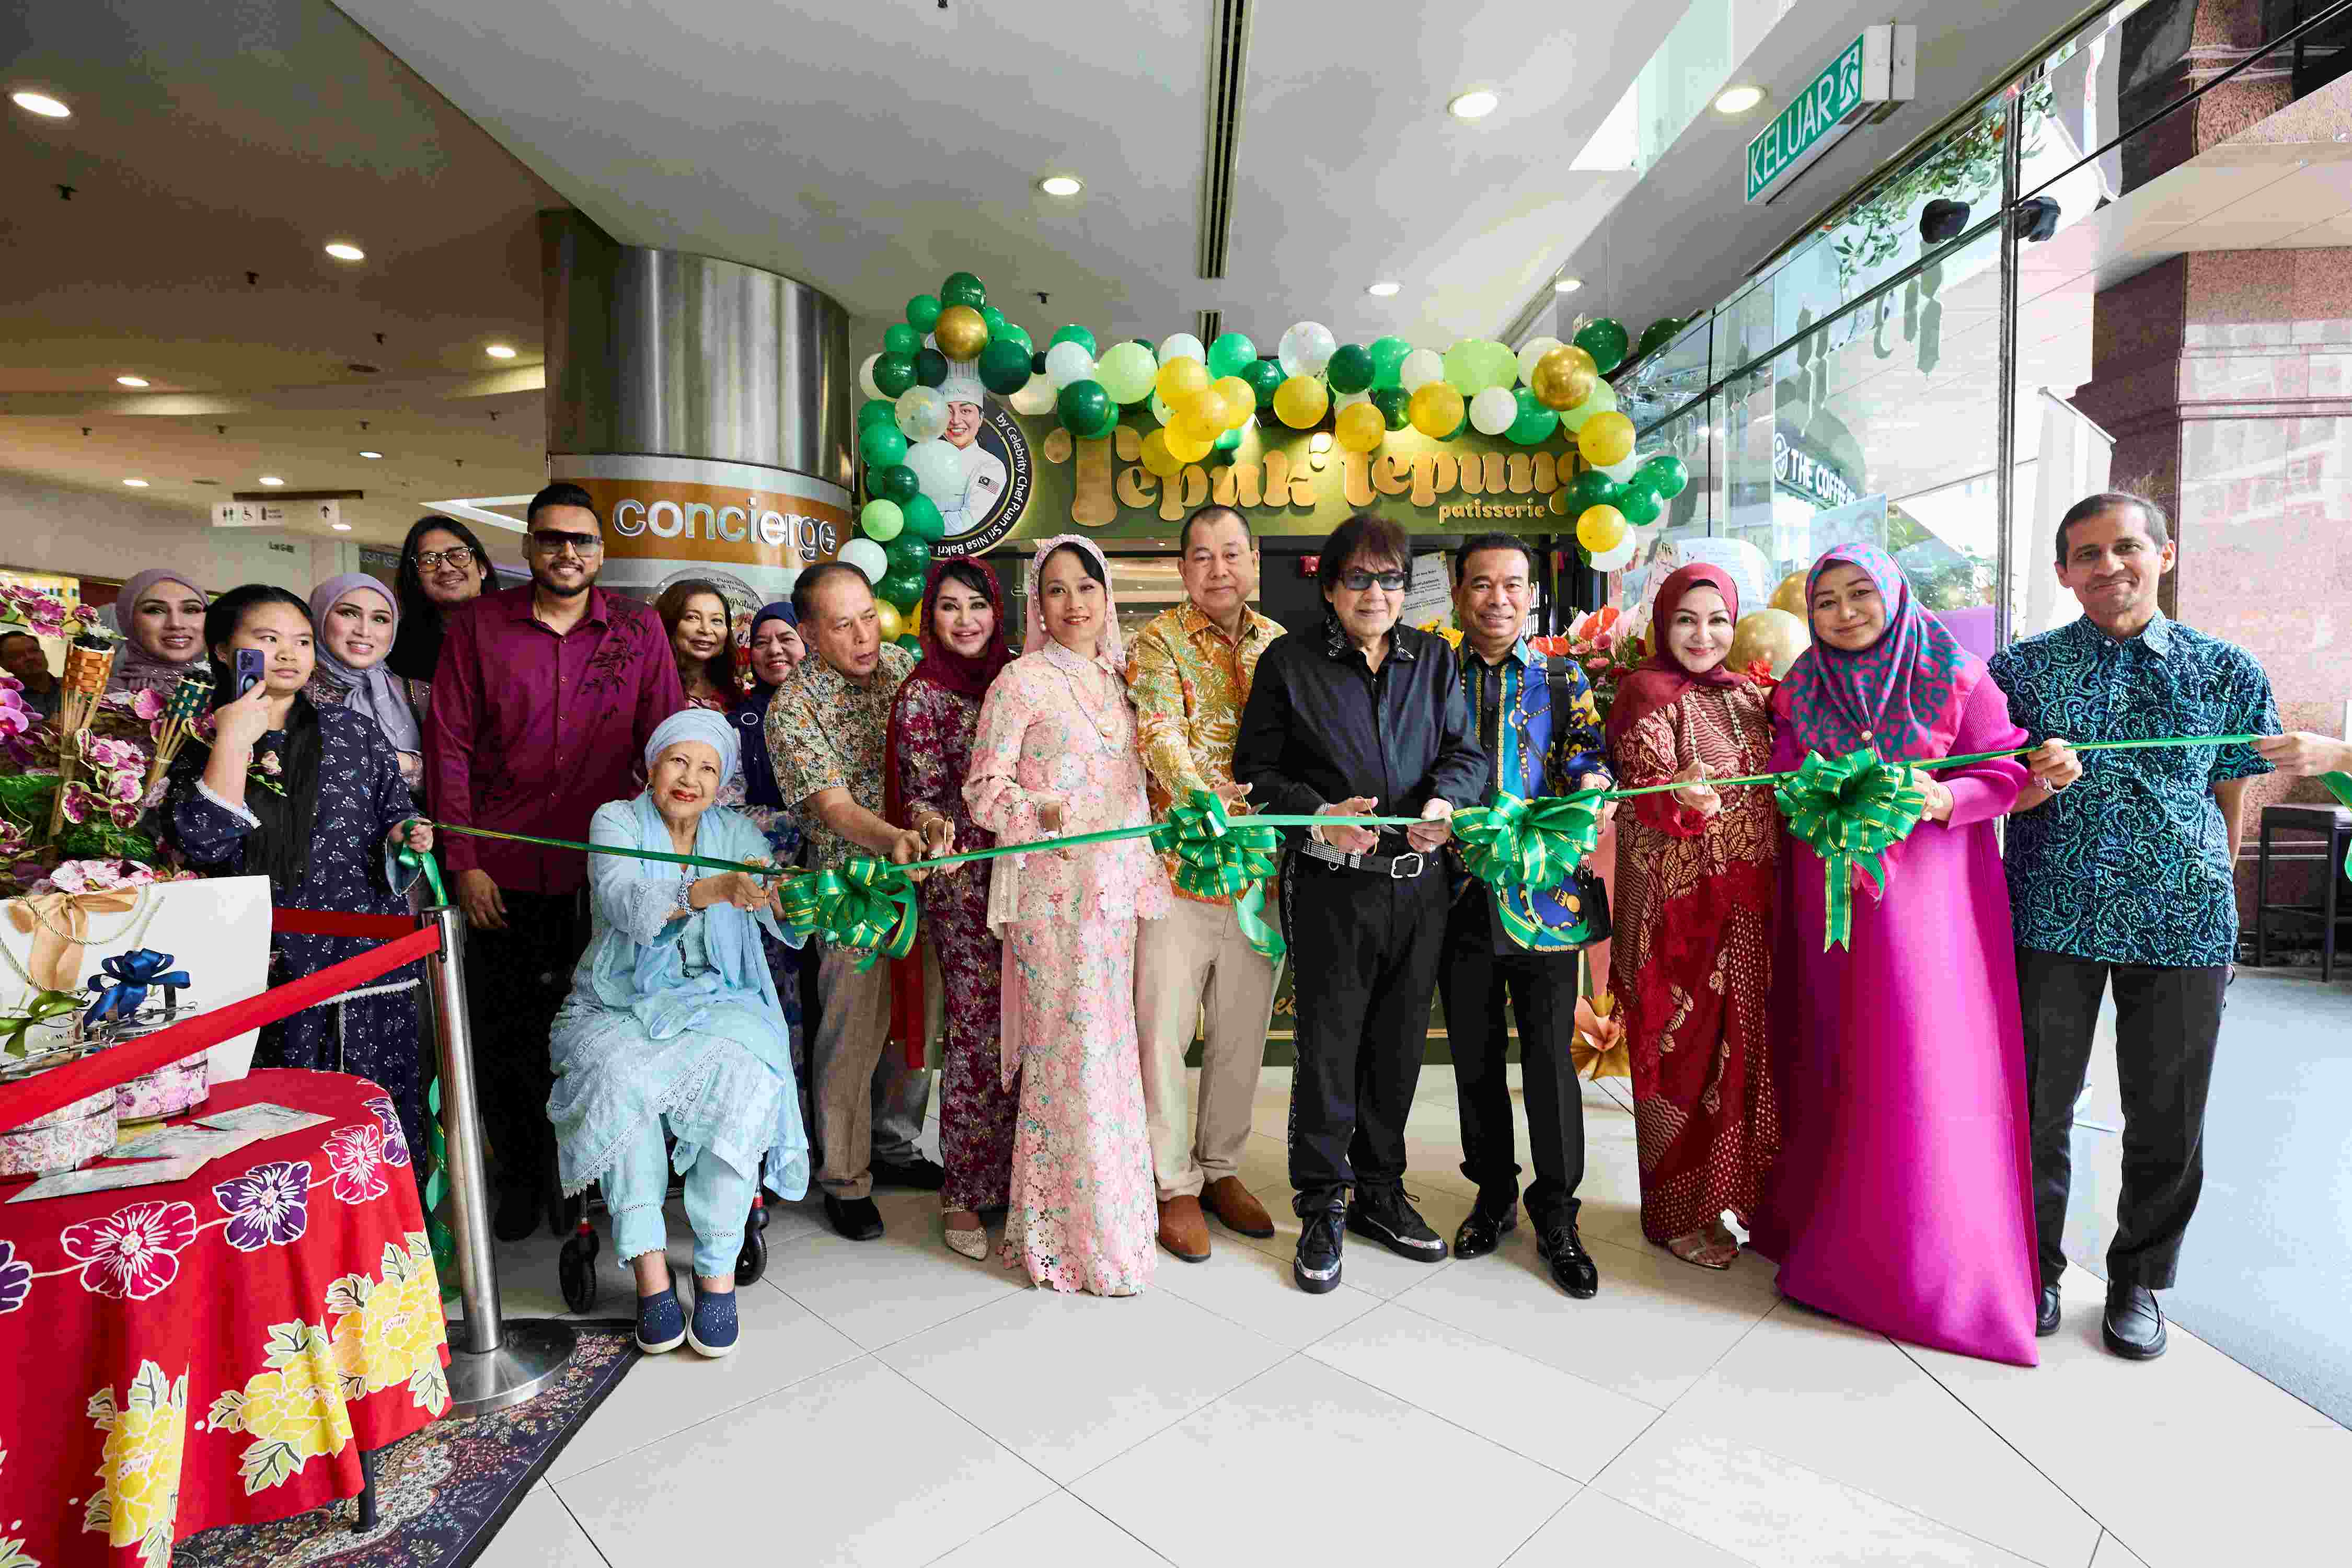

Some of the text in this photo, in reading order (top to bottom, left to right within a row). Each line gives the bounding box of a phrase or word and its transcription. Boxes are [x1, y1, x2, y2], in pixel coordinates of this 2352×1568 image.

[1751, 74, 1834, 192] KELUAR
[937, 412, 1028, 557] by Celebrity Chef Puan Sri Nisa Bakri
[1791, 447, 1813, 490] THE
[613, 497, 836, 562] concierge
[1438, 498, 1546, 524] patisserie
